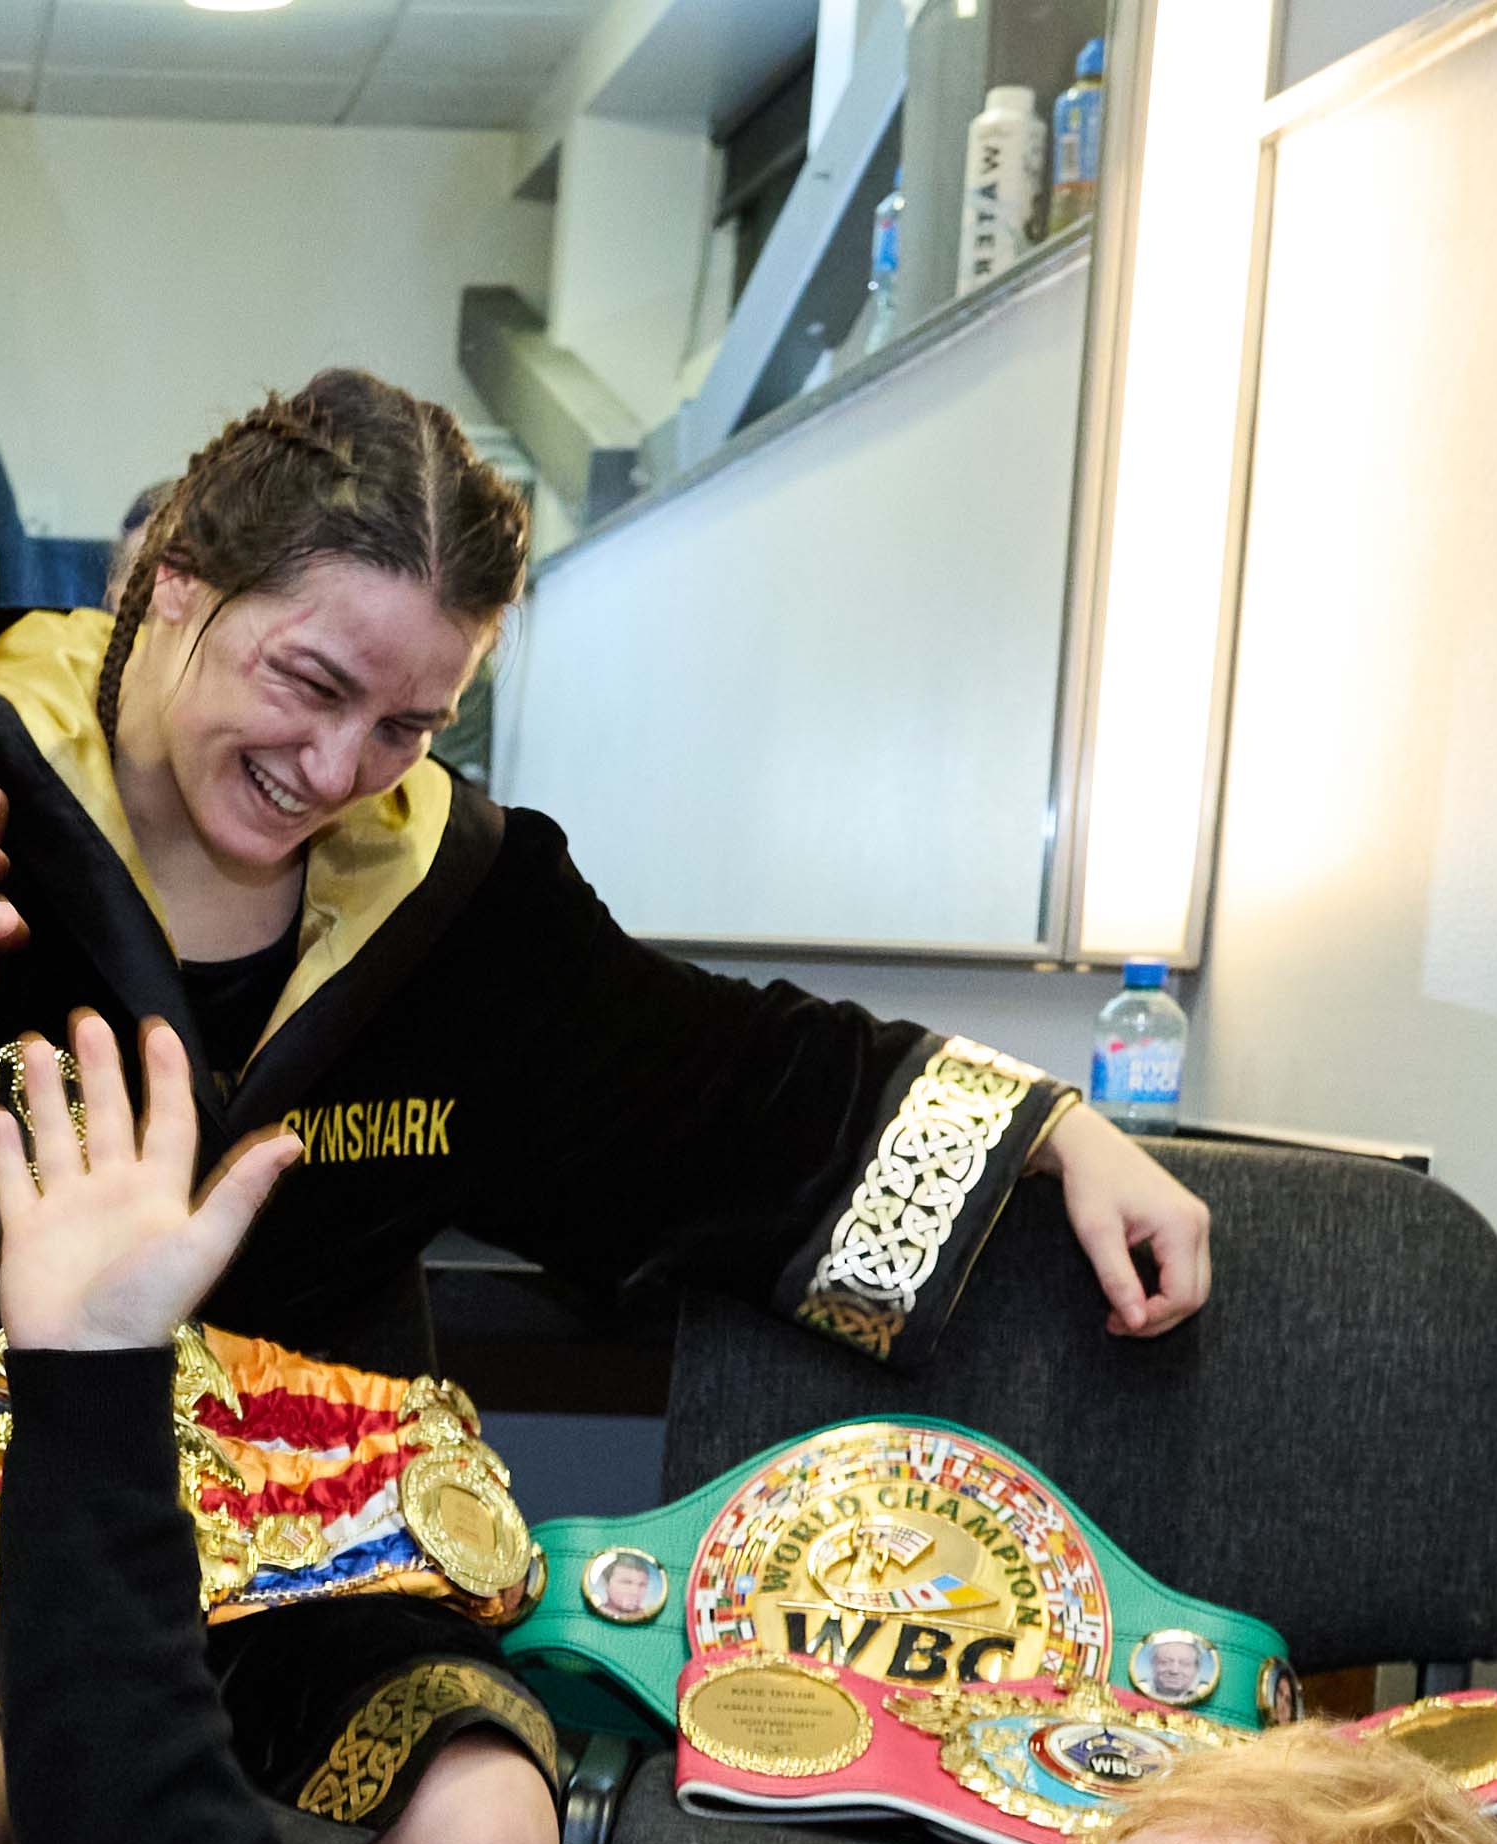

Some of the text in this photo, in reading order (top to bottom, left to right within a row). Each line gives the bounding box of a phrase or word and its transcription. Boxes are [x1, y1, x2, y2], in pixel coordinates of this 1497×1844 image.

[759, 1486, 1046, 1629] WORLD CHAMPION
[785, 1611, 1018, 1686] WBC
[1091, 1756, 1144, 1779] WBO
